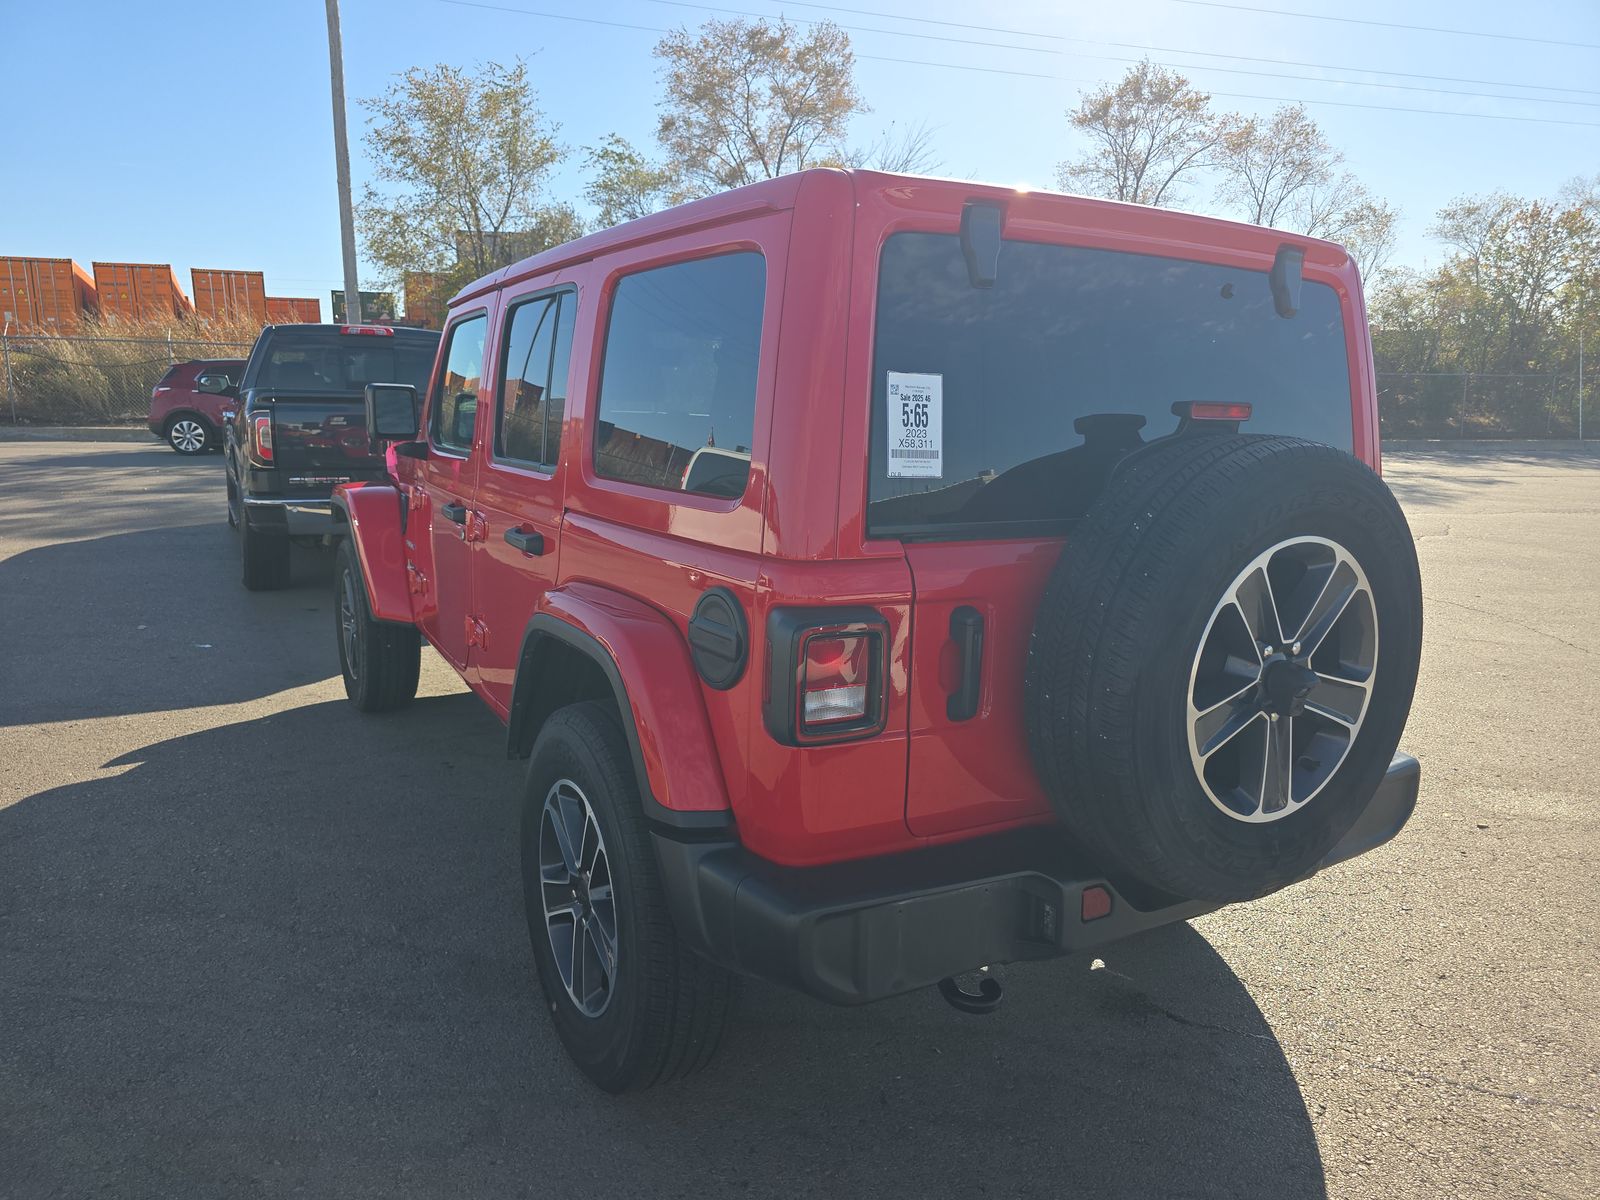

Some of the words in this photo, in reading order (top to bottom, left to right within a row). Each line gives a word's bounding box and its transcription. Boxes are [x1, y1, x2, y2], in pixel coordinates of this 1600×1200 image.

[900, 394, 911, 402] Sale
[912, 394, 924, 402] 2025
[902, 403, 928, 428] 5:65
[906, 429, 927, 438] 2023
[898, 438, 933, 449] X58,311
